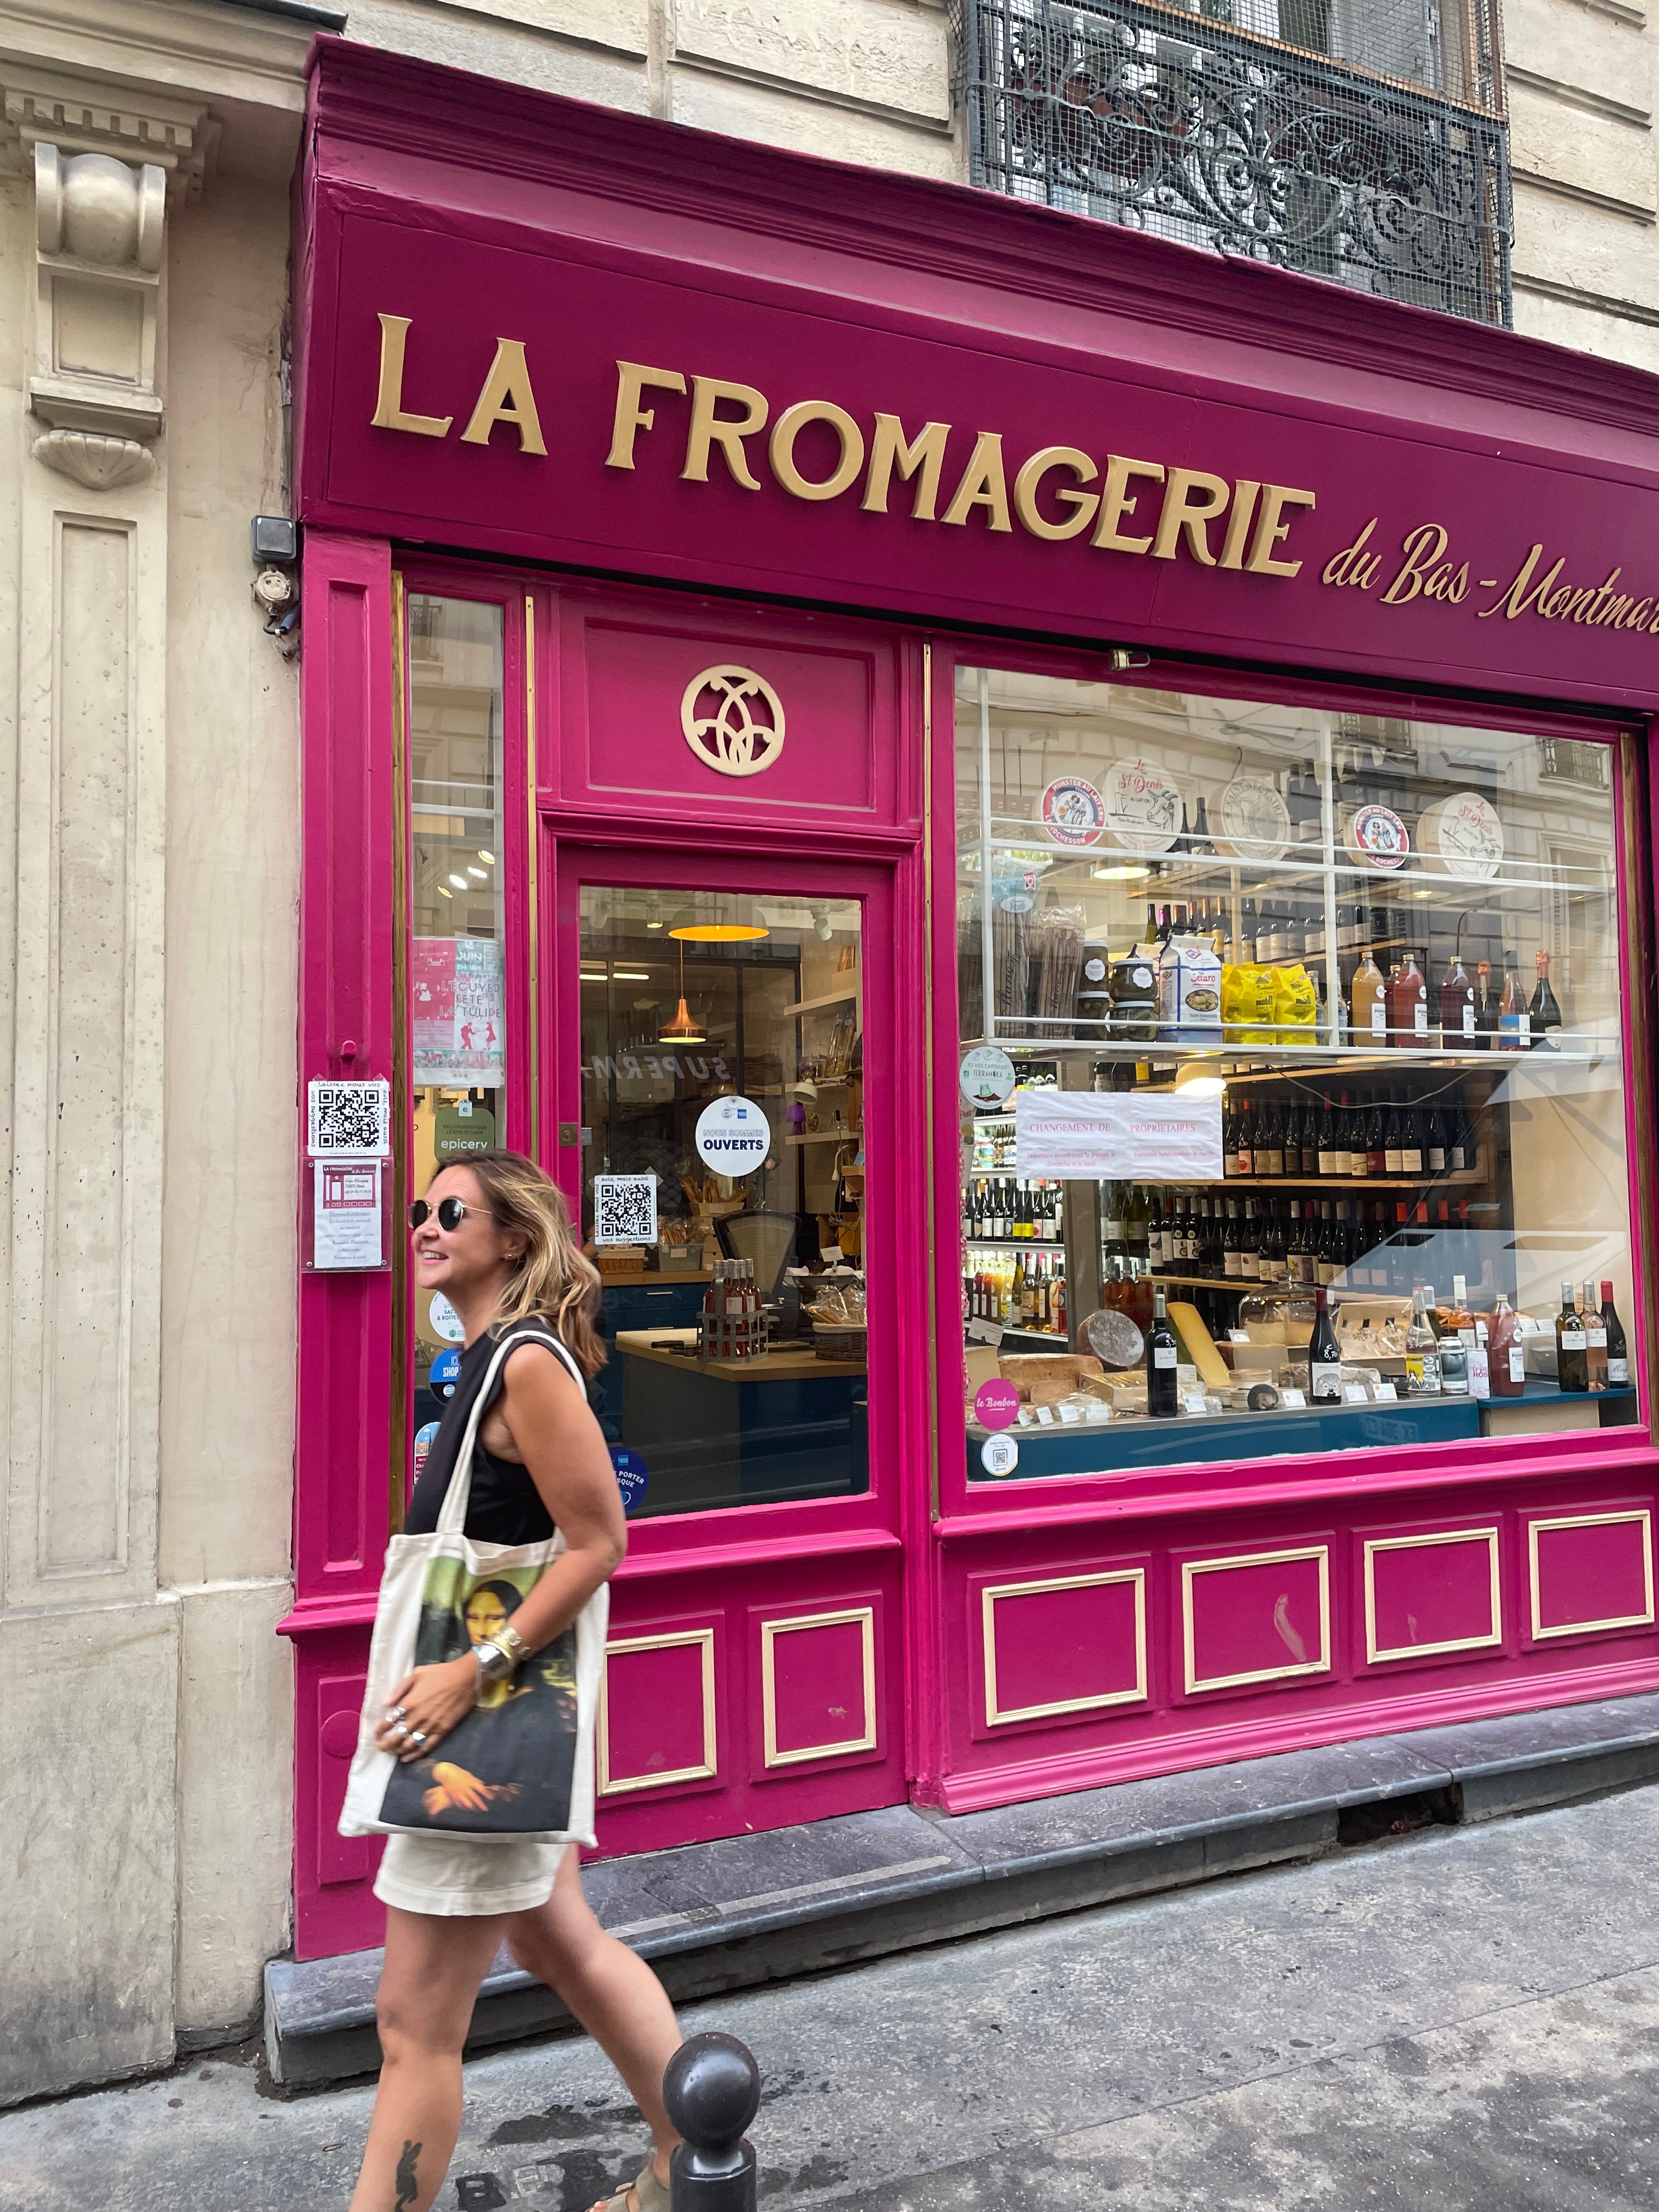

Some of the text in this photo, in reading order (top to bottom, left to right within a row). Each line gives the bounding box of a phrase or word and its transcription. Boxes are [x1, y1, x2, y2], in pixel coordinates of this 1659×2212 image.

[370, 313, 548, 455] LA
[605, 360, 1315, 577] FROMAGERIE
[1322, 517, 1383, 589] du
[1135, 759, 1147, 775] Le
[1118, 774, 1163, 793] St Denis
[1052, 780, 1081, 792] MUNSTER
[1090, 791, 1102, 805] LAIT
[1356, 809, 1372, 830] MUNSTER
[1393, 818, 1403, 829] CRU
[456, 952, 482, 962] JUIN
[1190, 973, 1216, 983] Setaro
[309, 1105, 317, 1148] suggestions
[1030, 1124, 1195, 1133] CHANGEMENT DE PROPRIETAIRES
[729, 1129, 764, 1137] SOMMES
[441, 1138, 488, 1152] epicery
[703, 1139, 764, 1150] OUVERTS
[1324, 1349, 1338, 1361] 8,70
[443, 1366, 459, 1378] SHOP
[977, 1397, 1017, 1408] le Bonbon
[617, 1478, 635, 1488] SQUE
[618, 1470, 645, 1485] PORTER
